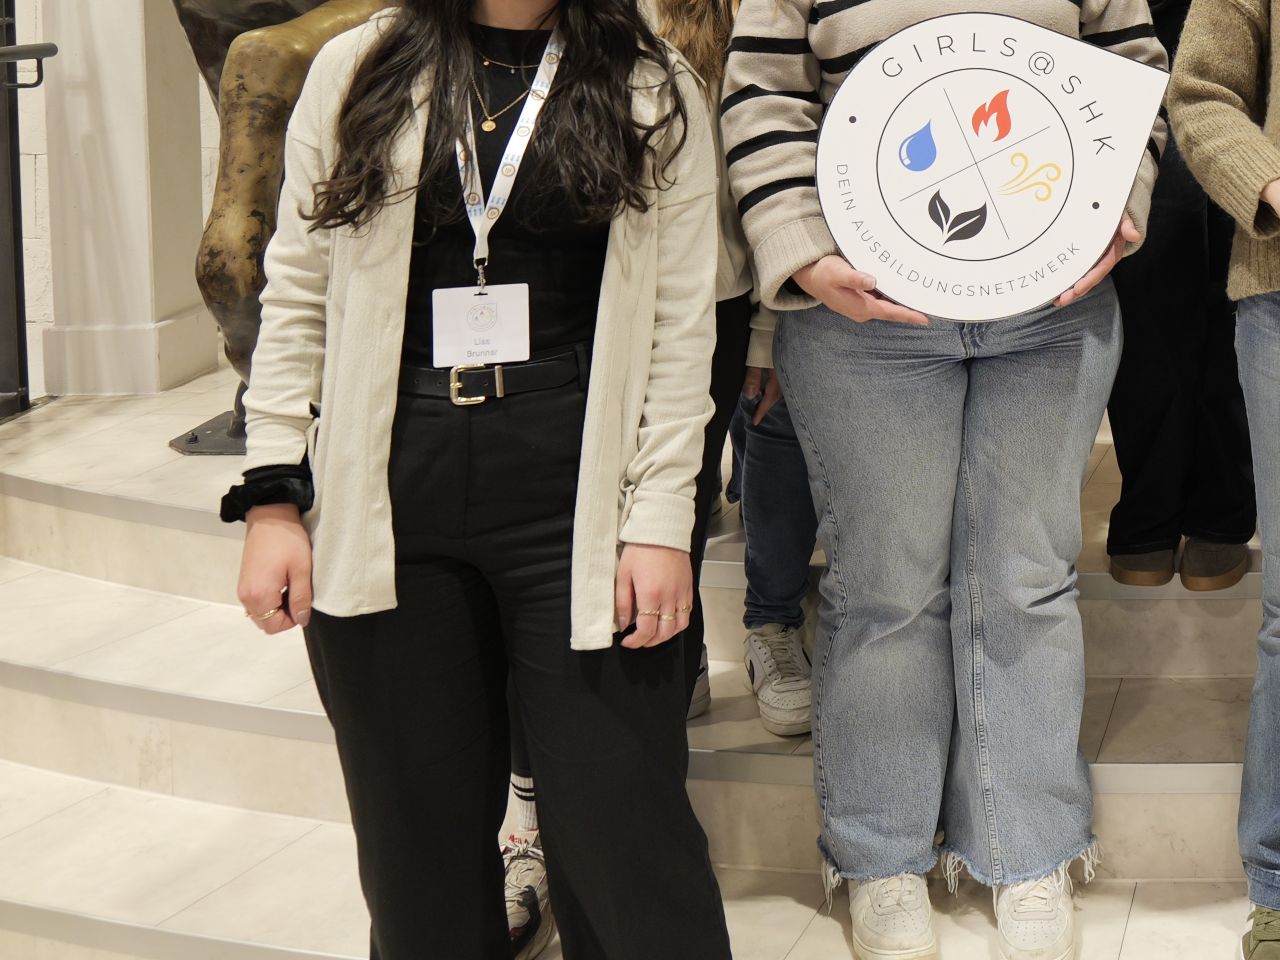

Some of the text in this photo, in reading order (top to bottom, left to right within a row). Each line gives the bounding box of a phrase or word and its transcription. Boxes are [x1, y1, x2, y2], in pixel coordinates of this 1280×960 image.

[882, 32, 1115, 155] GIRLS@SHK
[836, 163, 1080, 297] DEIN AUSBILDUNGSNETZWERK
